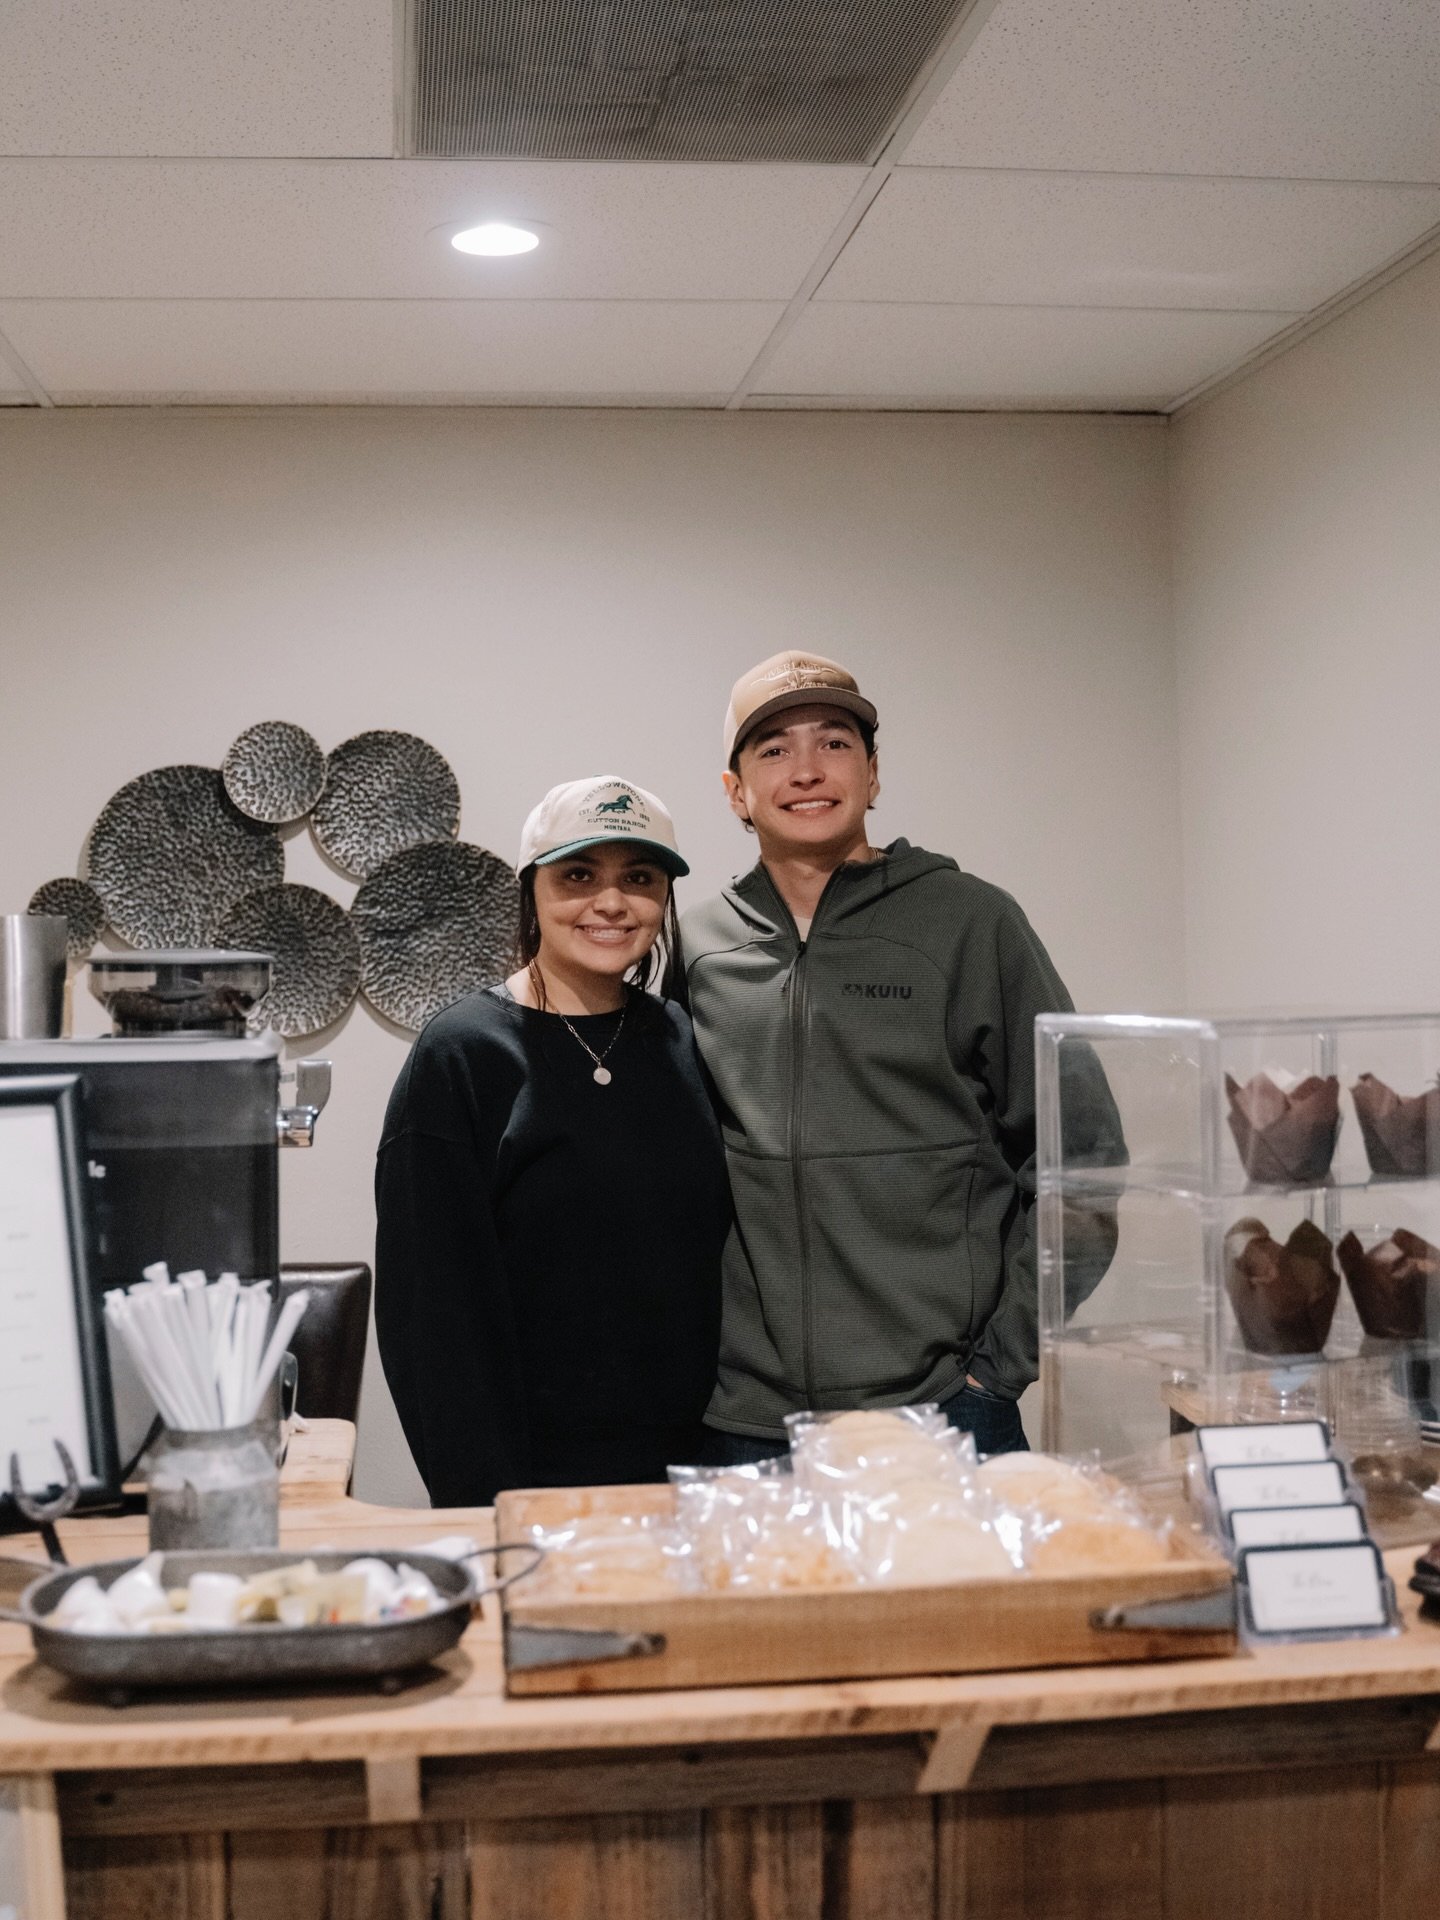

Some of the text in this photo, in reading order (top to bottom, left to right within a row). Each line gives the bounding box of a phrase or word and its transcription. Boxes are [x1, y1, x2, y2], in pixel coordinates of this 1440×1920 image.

[604, 824, 631, 832] MONTANA
[621, 818, 647, 829] RANCH
[865, 984, 912, 1000] KUIU
